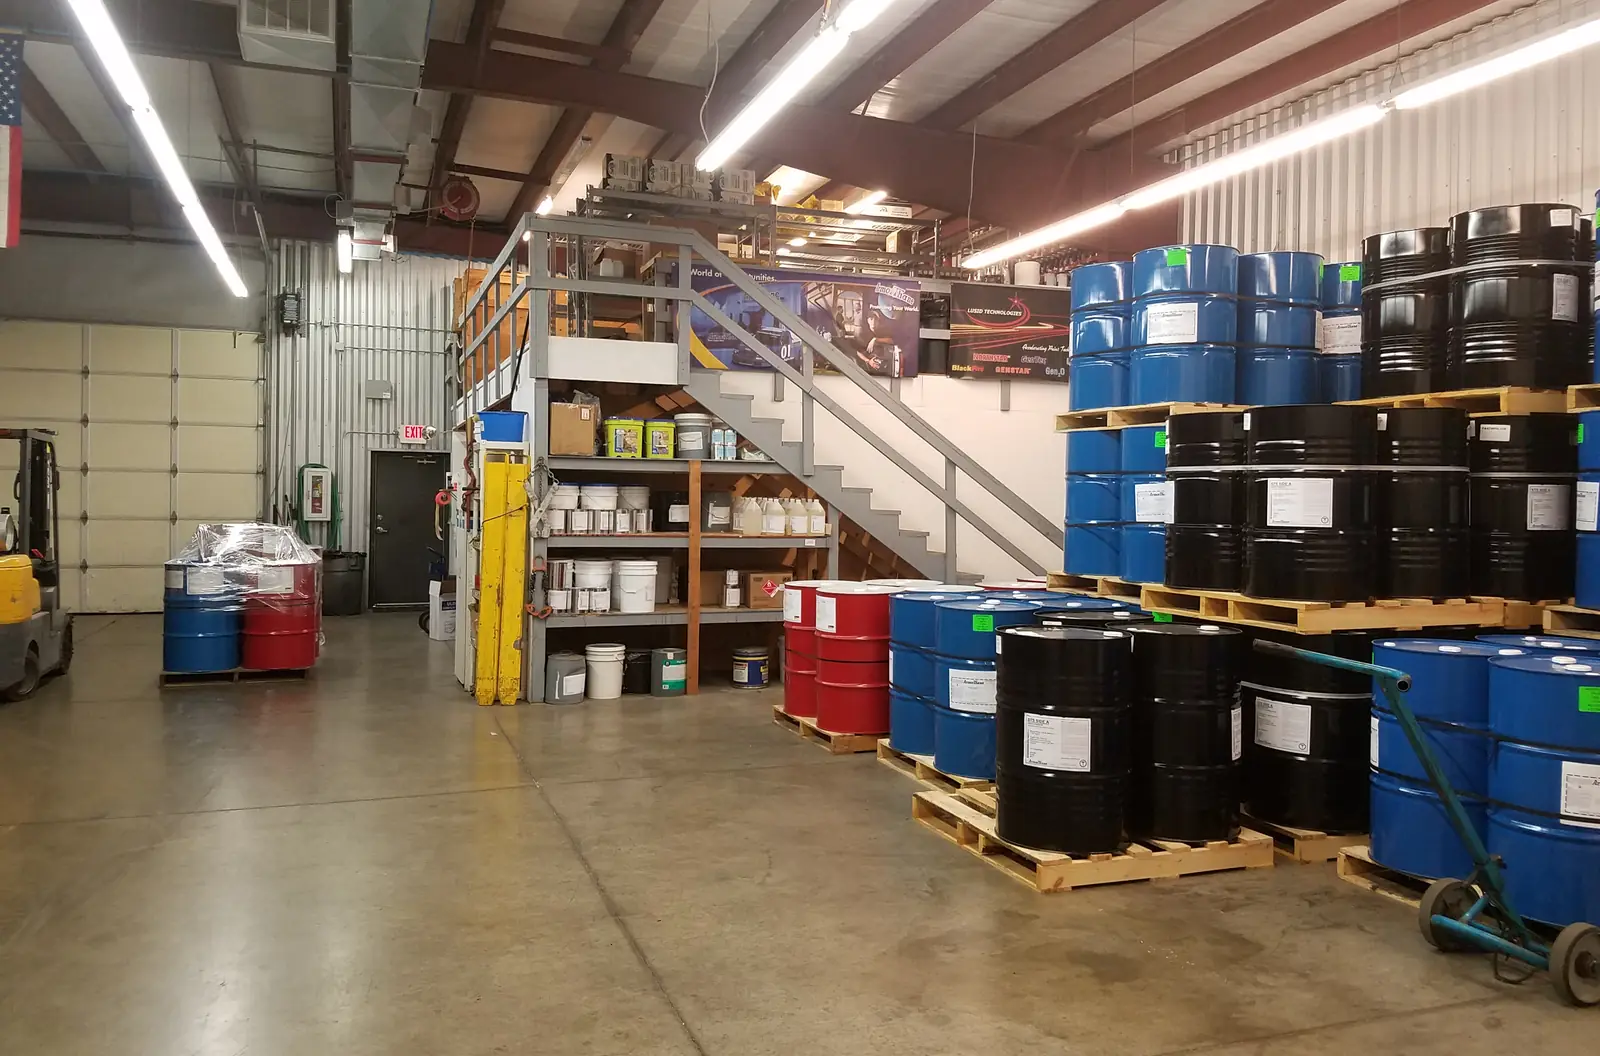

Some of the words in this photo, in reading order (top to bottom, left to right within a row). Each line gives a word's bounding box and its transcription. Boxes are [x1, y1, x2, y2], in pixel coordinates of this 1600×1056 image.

[690, 268, 713, 277] World
[984, 309, 1023, 317] TECHNOLOGIES
[780, 344, 791, 359] 01
[405, 426, 423, 439] EXIT
